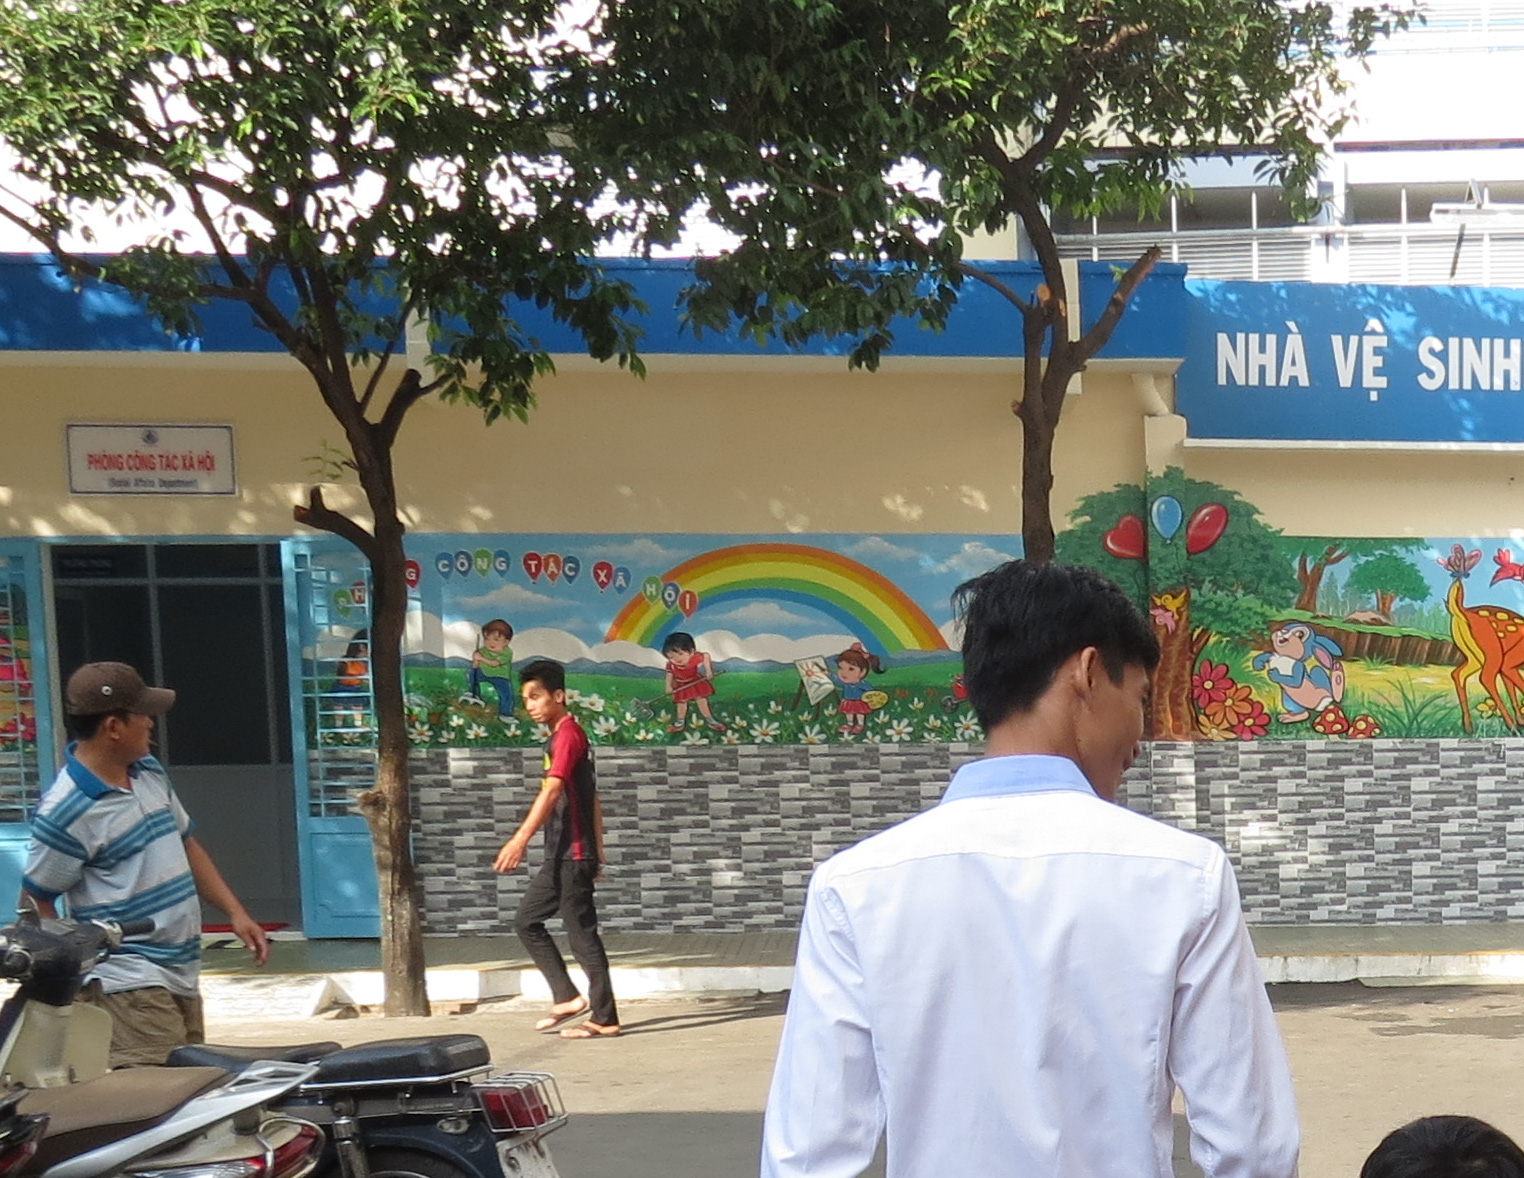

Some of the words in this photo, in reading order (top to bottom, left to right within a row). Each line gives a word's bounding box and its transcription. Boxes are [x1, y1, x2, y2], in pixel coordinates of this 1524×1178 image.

[1215, 322, 1310, 388] NHÀ
[1330, 318, 1389, 402] VỆ
[1416, 337, 1523, 393] SINH
[86, 450, 125, 471] PHÒNG
[126, 450, 157, 471] CÔNG
[158, 450, 179, 471] TÁC
[437, 551, 508, 573] CÔNG
[527, 556, 577, 578] TÁC
[597, 568, 628, 588] XÃ
